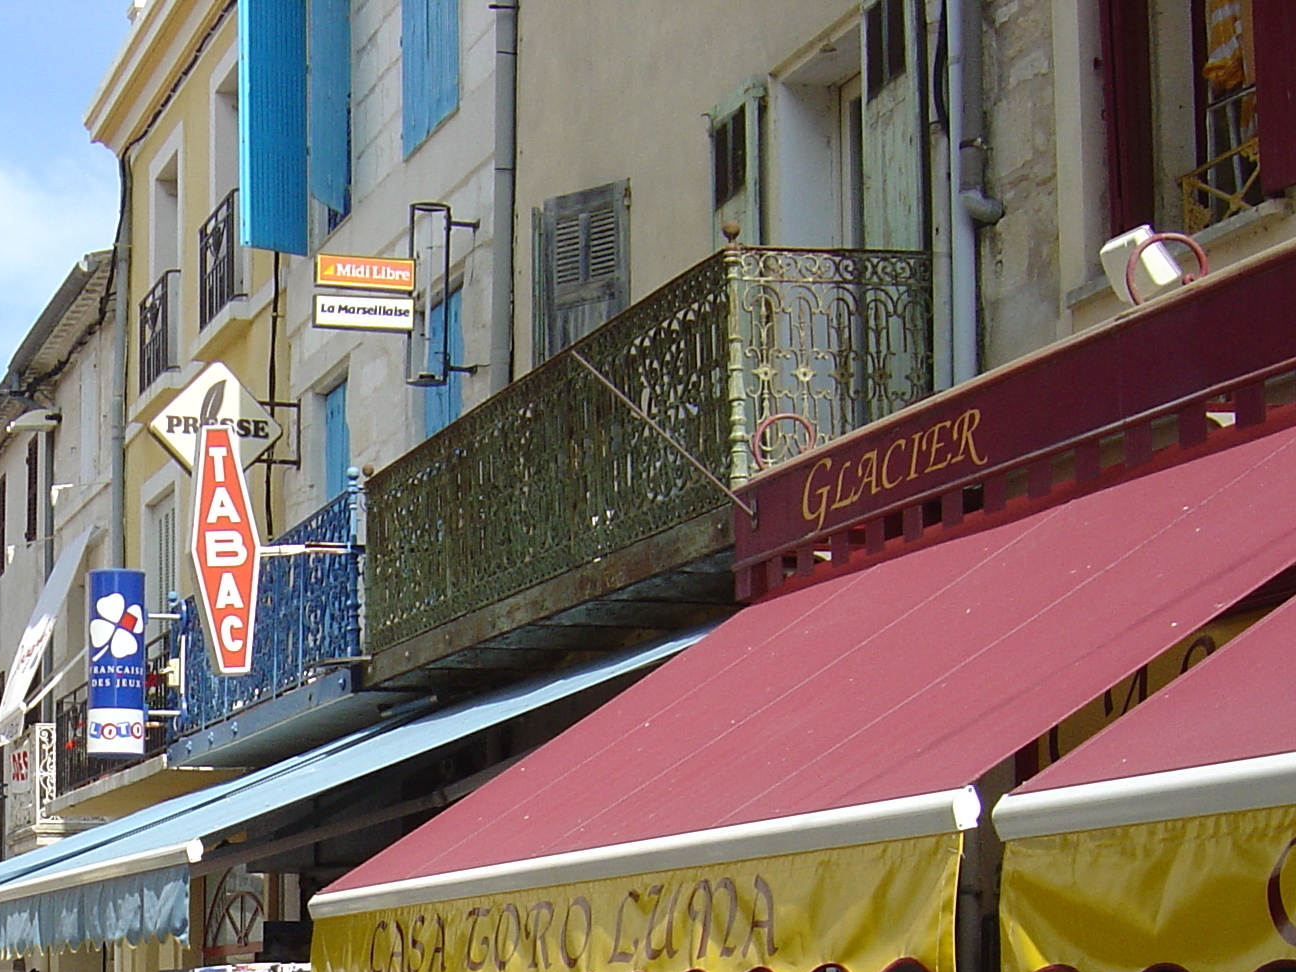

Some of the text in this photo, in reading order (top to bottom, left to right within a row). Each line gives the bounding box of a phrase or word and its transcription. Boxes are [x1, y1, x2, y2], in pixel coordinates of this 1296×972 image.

[336, 263, 411, 281] Midi Libre
[321, 303, 411, 317] La Marseillaise
[801, 408, 988, 534] GLACIER
[205, 446, 248, 652] TABAC
[91, 679, 141, 688] DES JEUX
[89, 721, 144, 740] LOTO
[466, 896, 593, 972] TORO
[607, 873, 780, 964] LUNA
